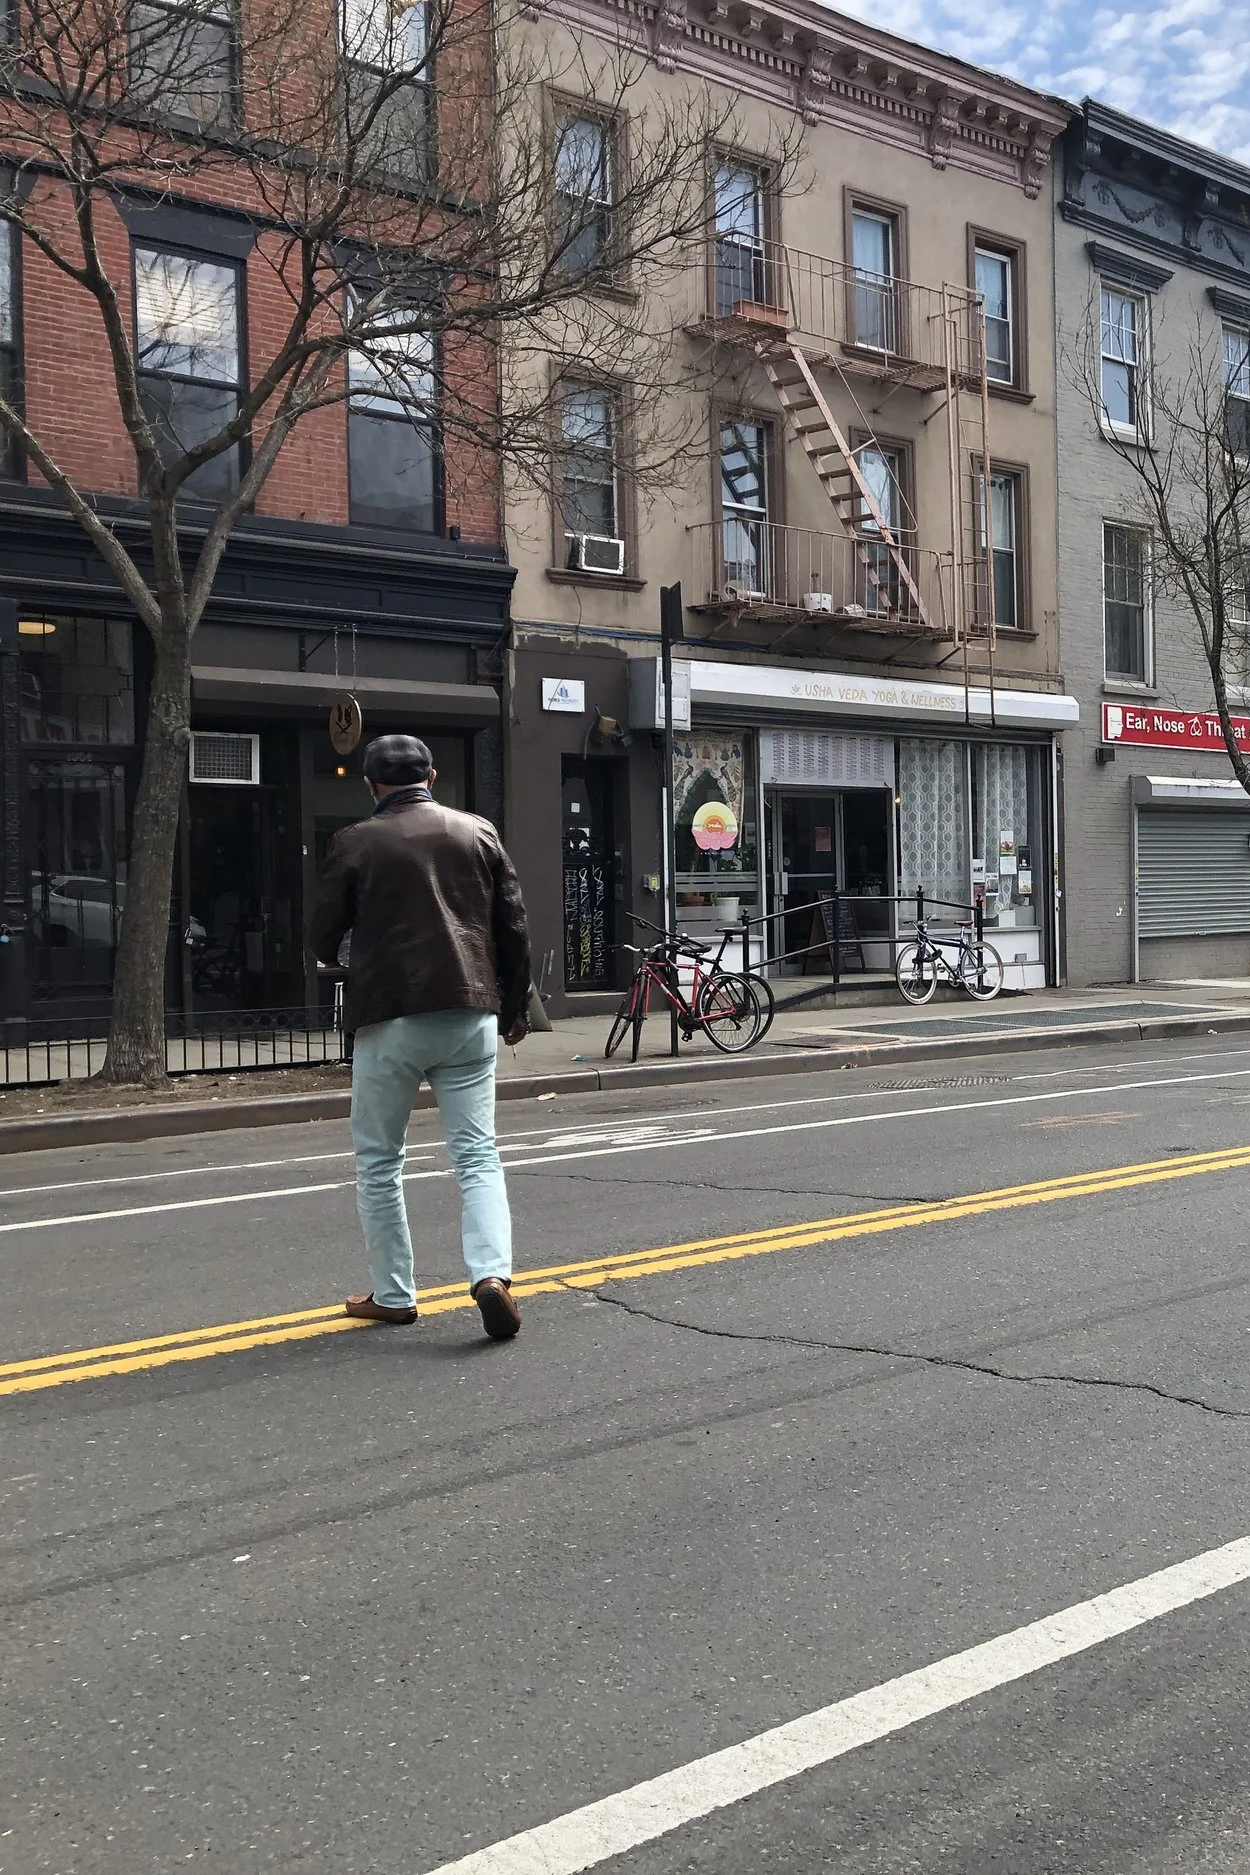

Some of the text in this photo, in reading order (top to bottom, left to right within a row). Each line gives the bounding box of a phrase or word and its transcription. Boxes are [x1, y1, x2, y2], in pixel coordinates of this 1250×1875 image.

[804, 684, 957, 711] USHA VEDA YOGA & WELLNESS
[1126, 712, 1150, 733] Ear,
[1153, 715, 1185, 733] Nose
[1205, 720, 1246, 739] That
